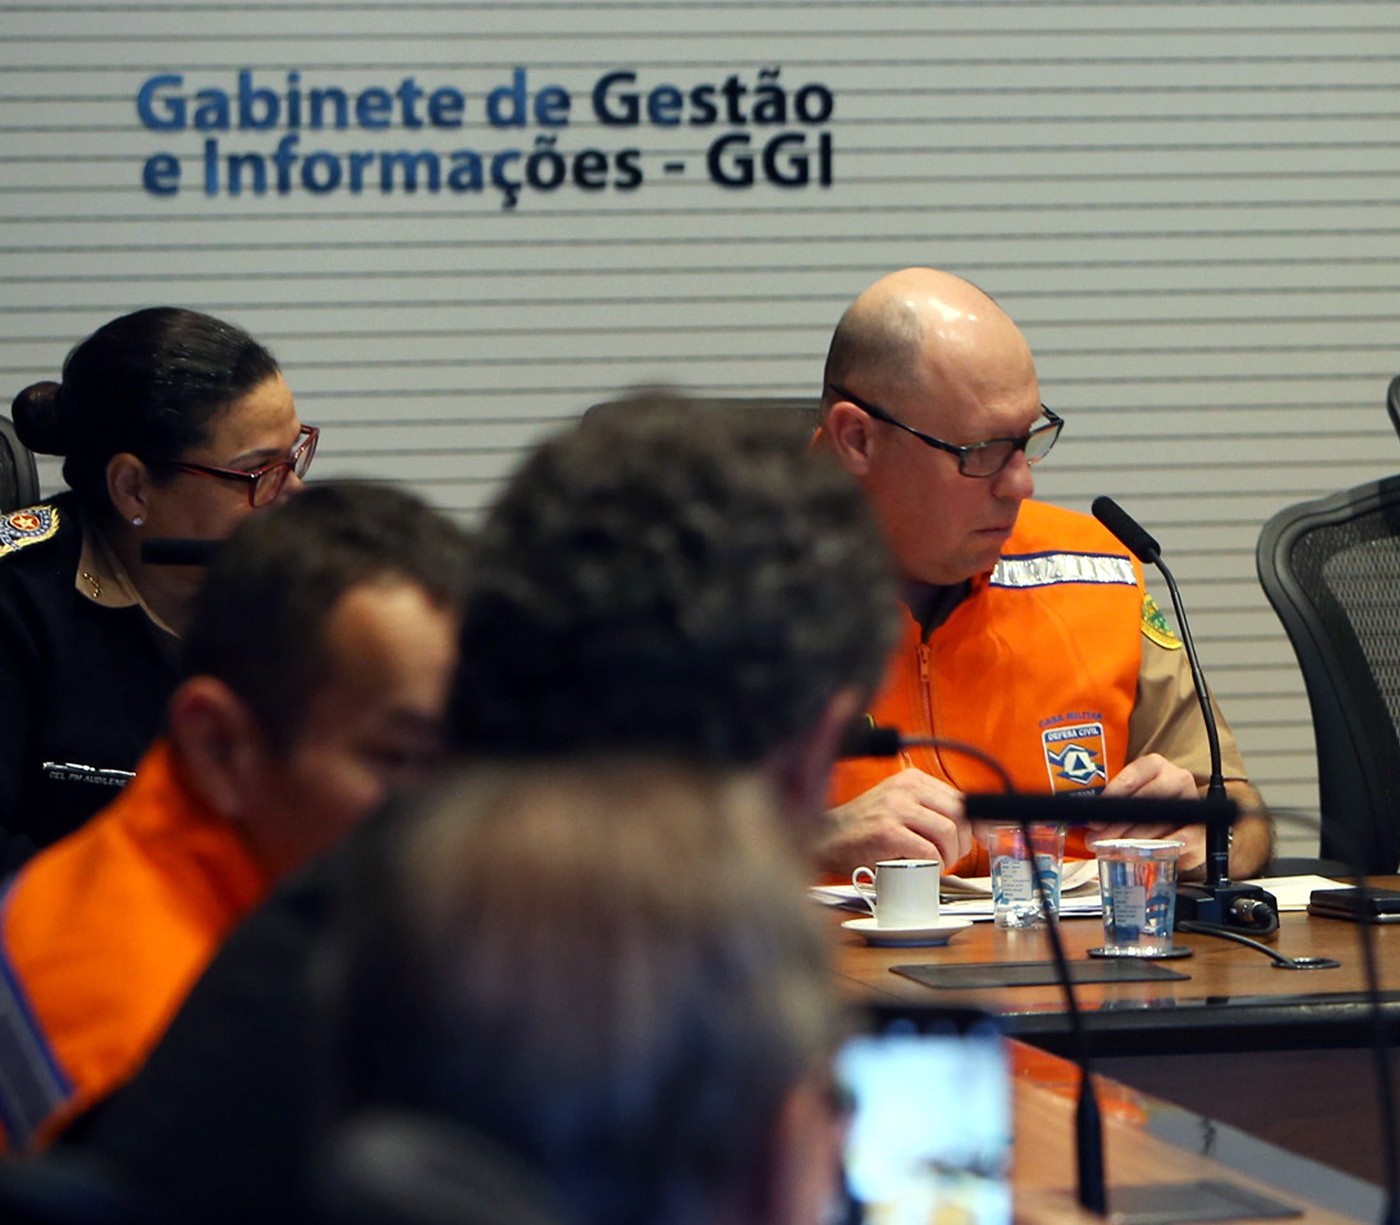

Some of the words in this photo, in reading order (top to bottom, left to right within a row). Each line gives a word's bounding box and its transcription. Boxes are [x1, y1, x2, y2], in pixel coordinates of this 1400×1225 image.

[135, 66, 466, 133] Gabinete
[485, 65, 573, 132] de
[590, 66, 836, 132] Gestão
[141, 151, 182, 196] e
[203, 132, 645, 212] Informações
[662, 161, 686, 175] -
[704, 131, 835, 190] GGI
[1047, 728, 1079, 741] DEFESA
[1078, 726, 1099, 737] CIVIL
